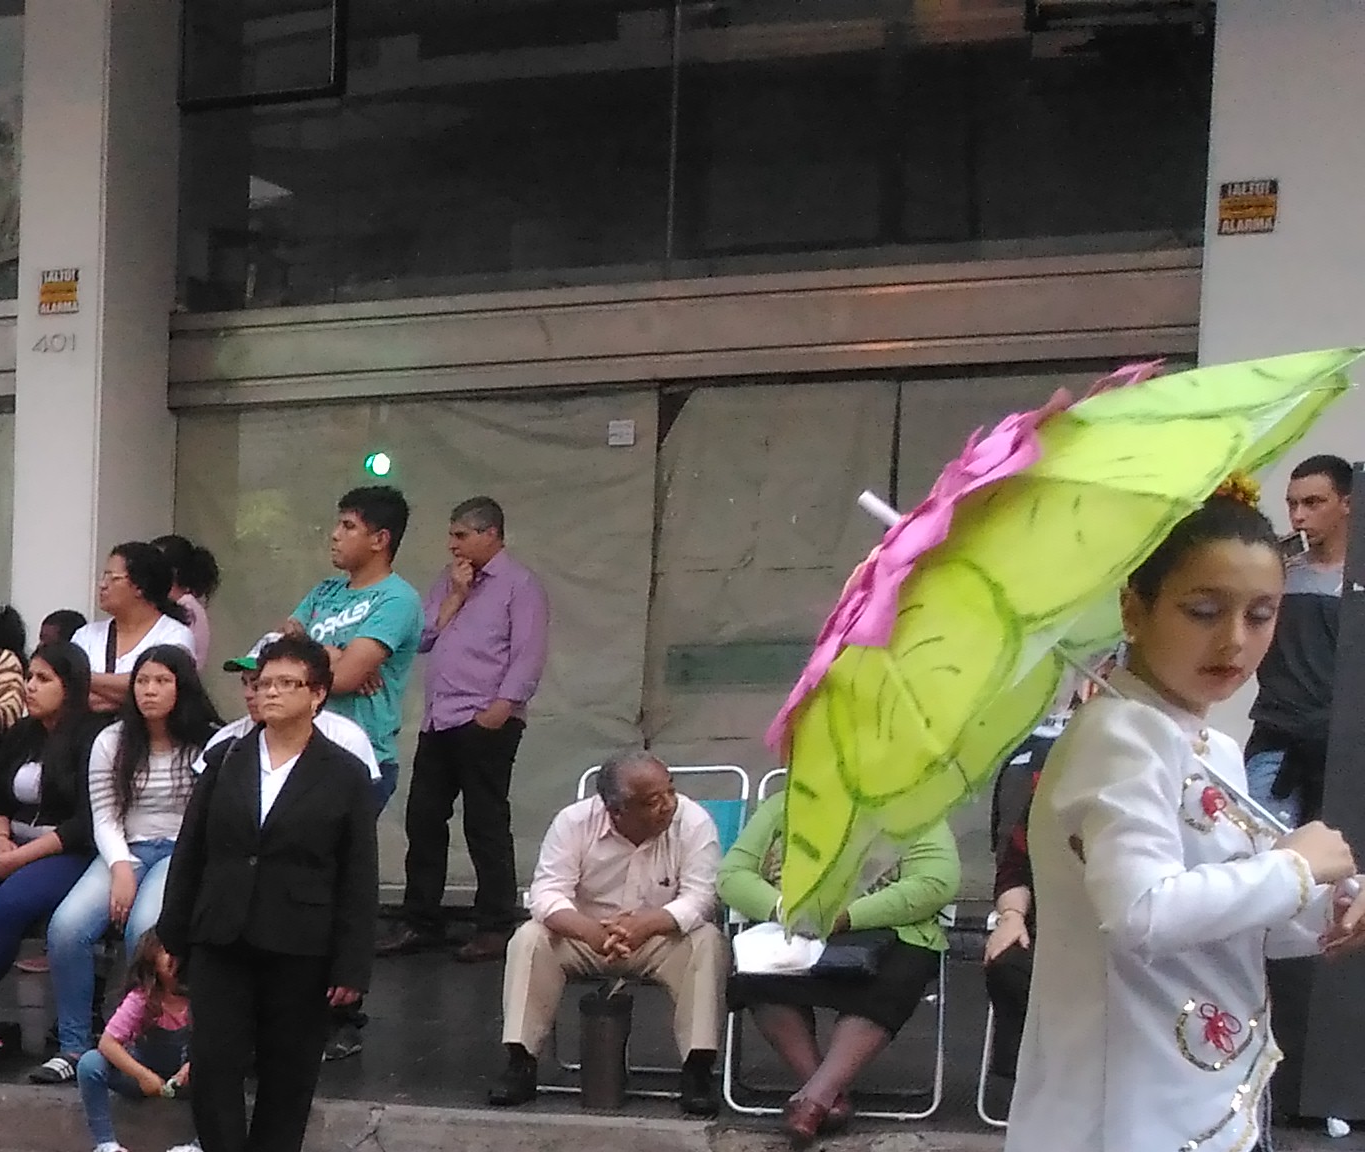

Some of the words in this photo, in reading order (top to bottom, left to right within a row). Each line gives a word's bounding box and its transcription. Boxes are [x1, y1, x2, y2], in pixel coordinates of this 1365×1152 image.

[1221, 218, 1274, 232] ALARMA
[39, 301, 79, 314] ALARMA
[31, 333, 77, 354] 401
